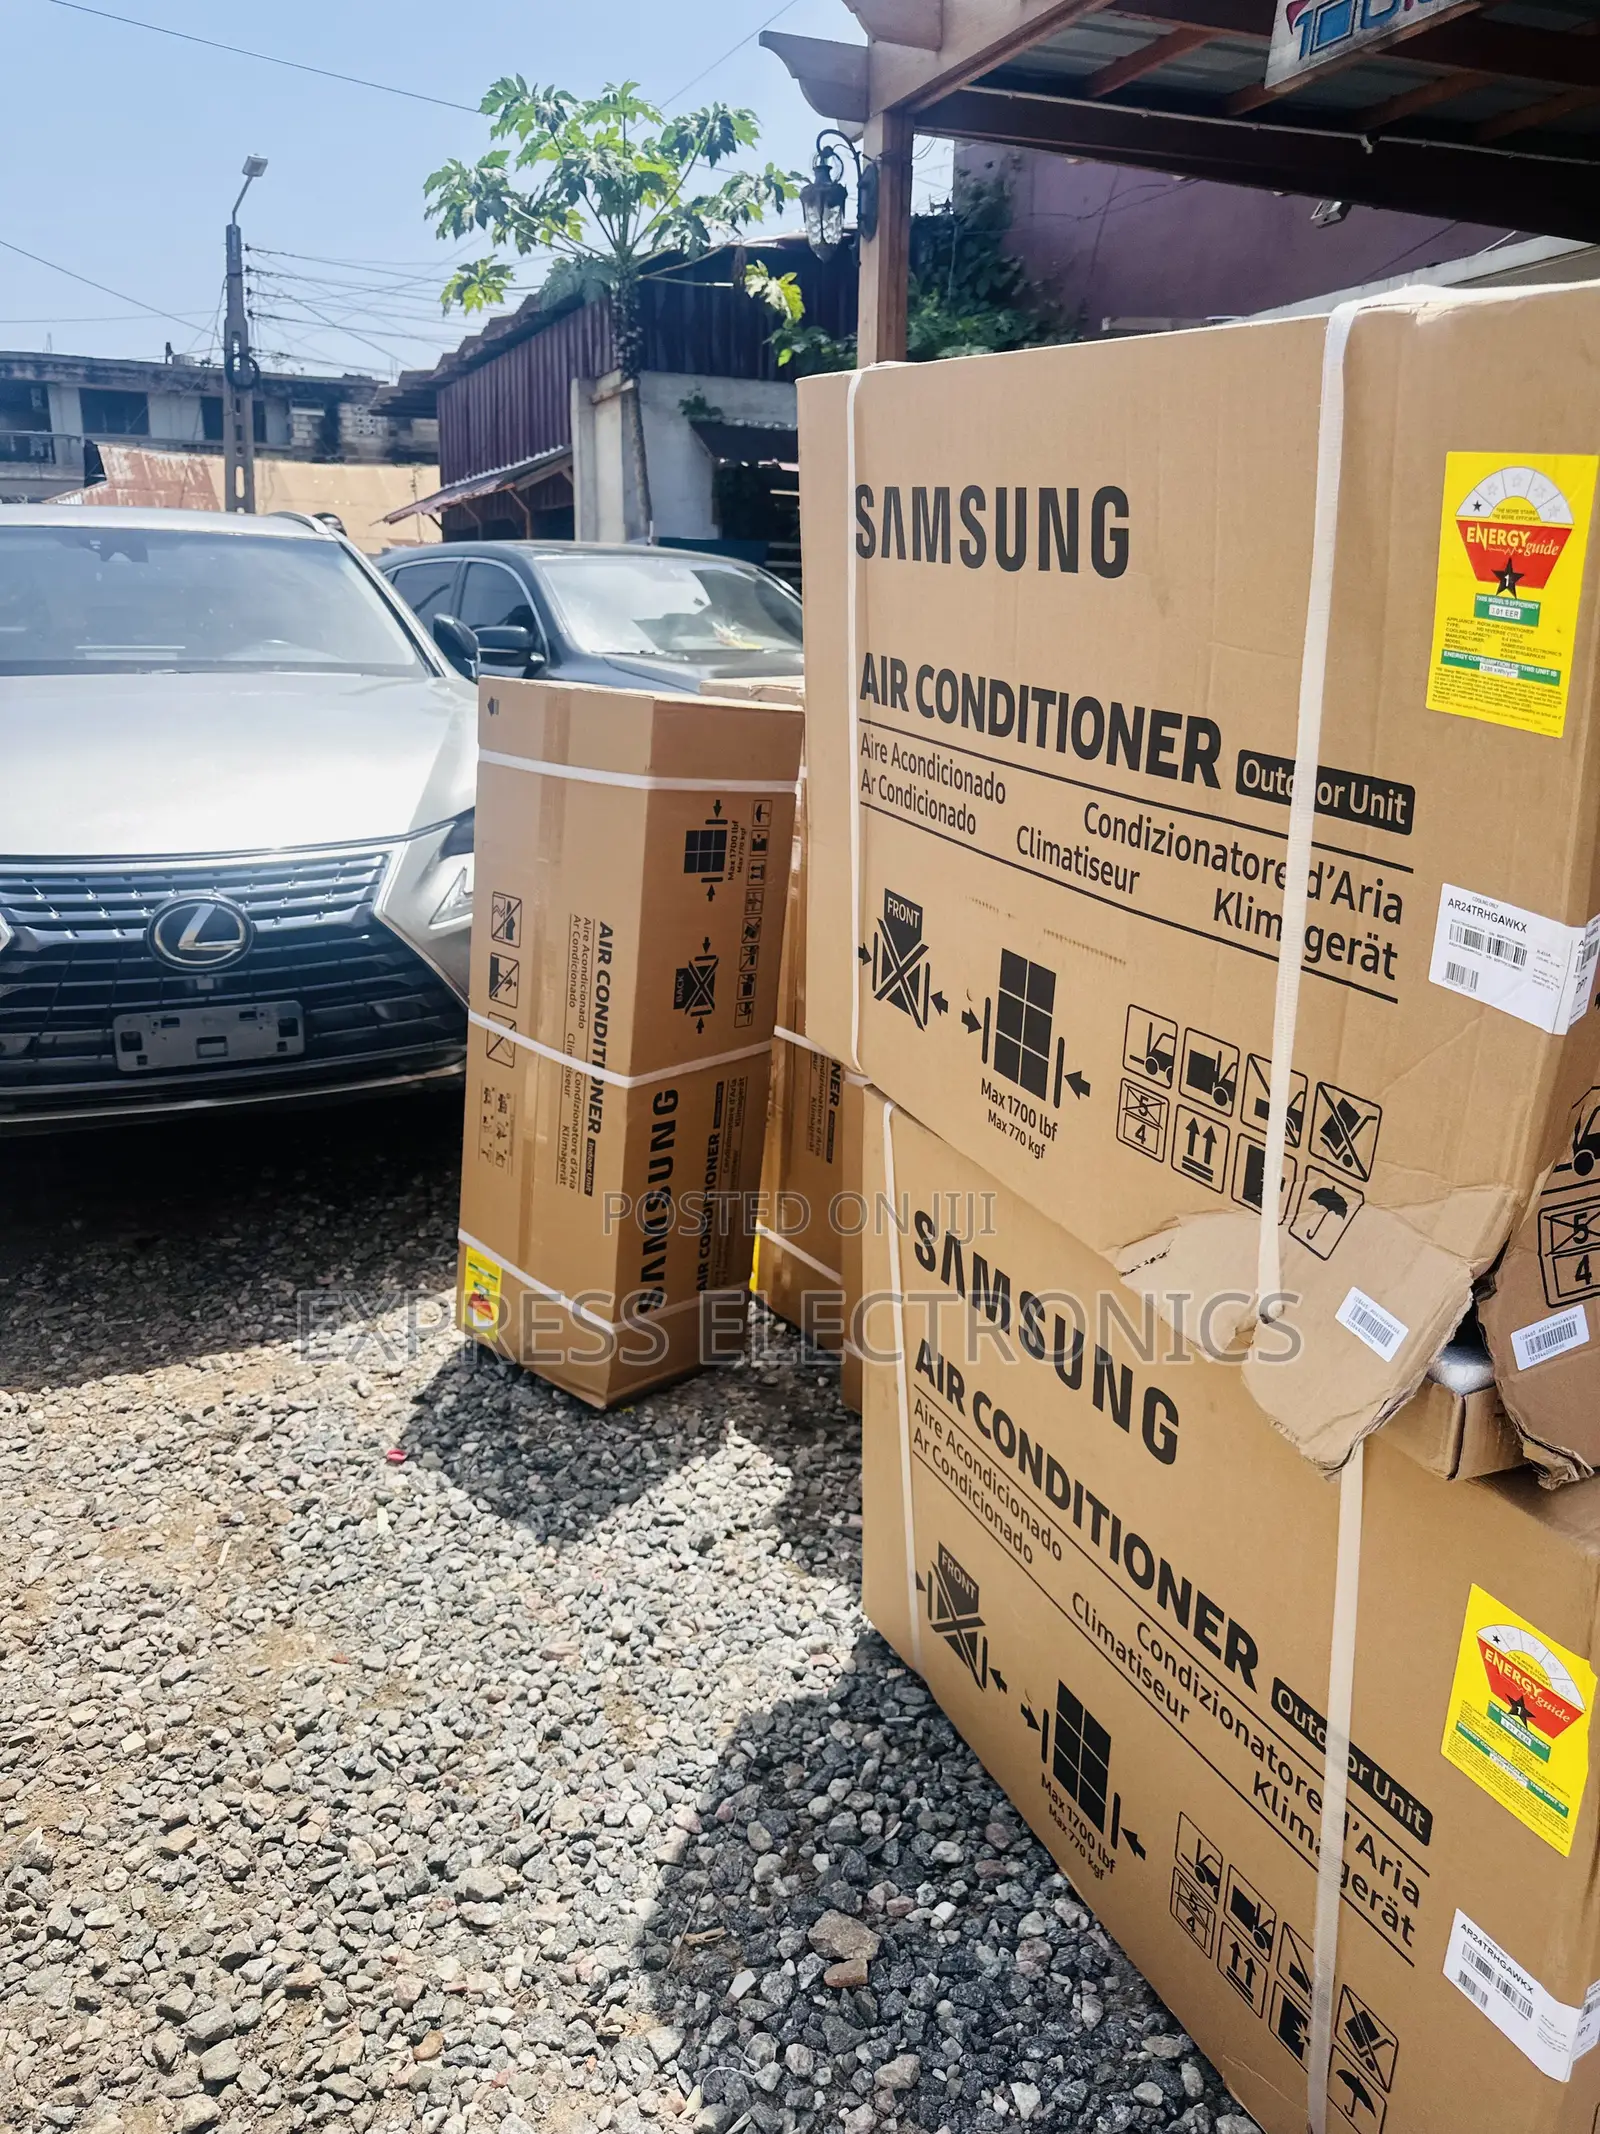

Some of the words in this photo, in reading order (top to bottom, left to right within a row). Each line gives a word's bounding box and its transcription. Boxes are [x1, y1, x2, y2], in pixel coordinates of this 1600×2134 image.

[855, 484, 1130, 579] SAMSUNG
[1467, 522, 1530, 551] ENERGY
[1523, 539, 1559, 557] guide
[1504, 574, 1510, 587] 1
[1509, 600, 1540, 610] EFFICIENCY
[1504, 609, 1519, 618] EER
[1444, 650, 1468, 660] ENERGY
[1535, 668, 1550, 676] UNIT
[859, 652, 909, 713] AIR
[915, 663, 1222, 789] CONDITIONER
[1349, 781, 1407, 825] Unit
[860, 732, 888, 765] Aire
[891, 741, 1006, 805] Acondicionado
[730, 820, 740, 834] lbf
[860, 768, 876, 795] Ar
[878, 773, 976, 836] Condicionado
[726, 859, 736, 881] Max
[728, 834, 739, 859] 1700
[1016, 825, 1140, 895] Climatiseur
[1084, 802, 1287, 891] Condizionatore
[572, 914, 581, 930] Ar
[581, 917, 592, 942] Aire
[596, 921, 614, 965] AIR
[887, 896, 920, 930] FRONT
[1213, 887, 1398, 981] Klimgerät
[1448, 898, 1528, 934] AR24TRHGAWKX
[568, 930, 581, 1009] Condicionado
[578, 944, 591, 1029] Acondicionado
[676, 975, 684, 1003] BACK
[570, 1071, 584, 1155] Condizionatore
[980, 1077, 1006, 1113] Max
[1006, 1095, 1036, 1130] 1700
[1039, 1113, 1058, 1142] lbf
[987, 1109, 1007, 1136] Max
[1008, 1123, 1026, 1147] 770
[1028, 1133, 1046, 1160] kgf
[1134, 1124, 1147, 1145] 4
[558, 1124, 570, 1186] Klimagerät
[568, 1157, 580, 1190] d'Aria
[584, 1172, 593, 1194] Unit
[586, 1140, 596, 1171] Indoor
[638, 1088, 679, 1314] SAMSUNG
[698, 1132, 720, 1259] CONDITIONER
[696, 1263, 709, 1291] AIR
[1574, 1254, 1592, 1286] 4
[913, 1209, 1180, 1466] SAMSUNG
[914, 1397, 943, 1437] Aire
[946, 1429, 1062, 1562] Acondicionado
[914, 1426, 931, 1455] Ar
[932, 1441, 1033, 1565] Condicionado
[915, 1337, 966, 1418] AIR
[972, 1389, 1259, 1695] CONDITIONER
[1372, 1771, 1428, 1836] Unit
[941, 1551, 977, 1601] FRONT
[1072, 1591, 1190, 1725] Climatiseur
[1484, 1648, 1543, 1697] ENERGY
[1535, 1696, 1571, 1723] guide
[1136, 1621, 1322, 1815] Condizionatore
[1041, 1772, 1067, 1812] Max
[1067, 1806, 1096, 1852] 1700
[1098, 1837, 1116, 1875] lbf
[1048, 1801, 1069, 1836] Max
[1069, 1827, 1087, 1860] 770
[1087, 1850, 1105, 1882] kgf
[1460, 1923, 1534, 1995] AR24TRHGAWKX
